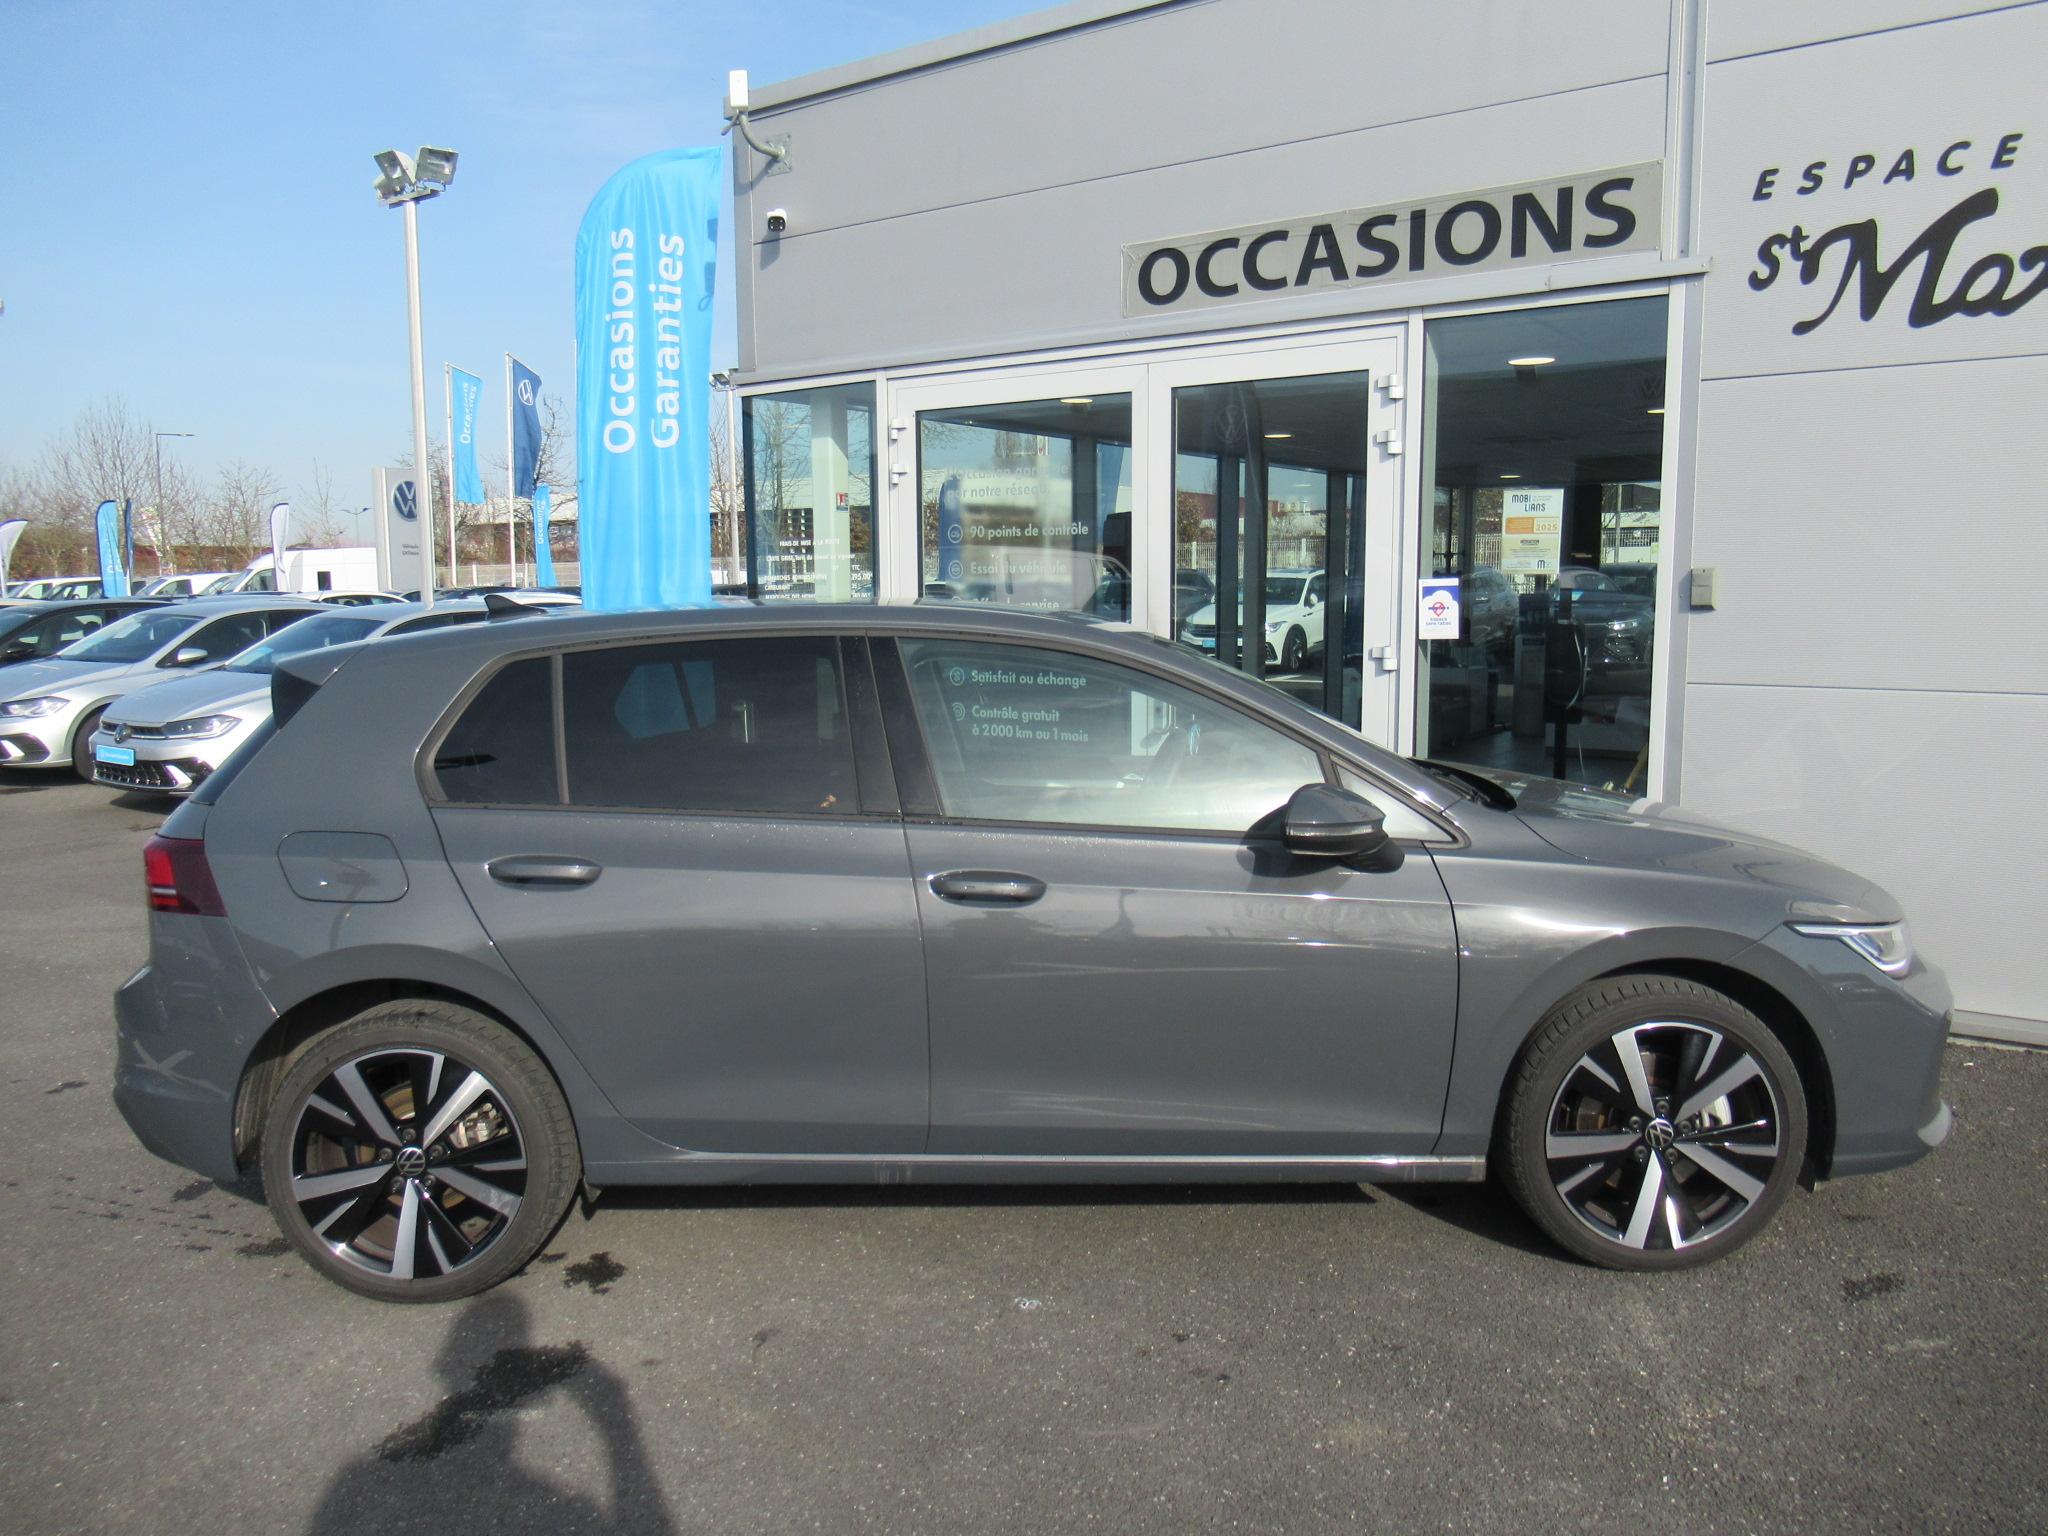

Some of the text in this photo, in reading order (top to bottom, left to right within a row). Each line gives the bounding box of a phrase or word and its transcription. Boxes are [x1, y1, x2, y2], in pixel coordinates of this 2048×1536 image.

[1752, 133, 2023, 201] ESPACE
[1138, 177, 1636, 306] OCCASIONS
[603, 227, 636, 454] Occasions
[648, 233, 685, 449] Garanties
[971, 486, 1001, 498] notre
[970, 522, 1088, 541] 90 points de contrôle
[1536, 523, 1558, 531] 2025
[970, 560, 998, 574] Essai
[972, 670, 1086, 689] Satisfait ou échange
[972, 705, 1060, 723] Contrôle gratuit
[972, 724, 979, 736] à
[1016, 725, 1032, 738] km
[1036, 730, 1050, 740] ou
[1053, 728, 1058, 740] 1
[1061, 730, 1088, 742] mois
